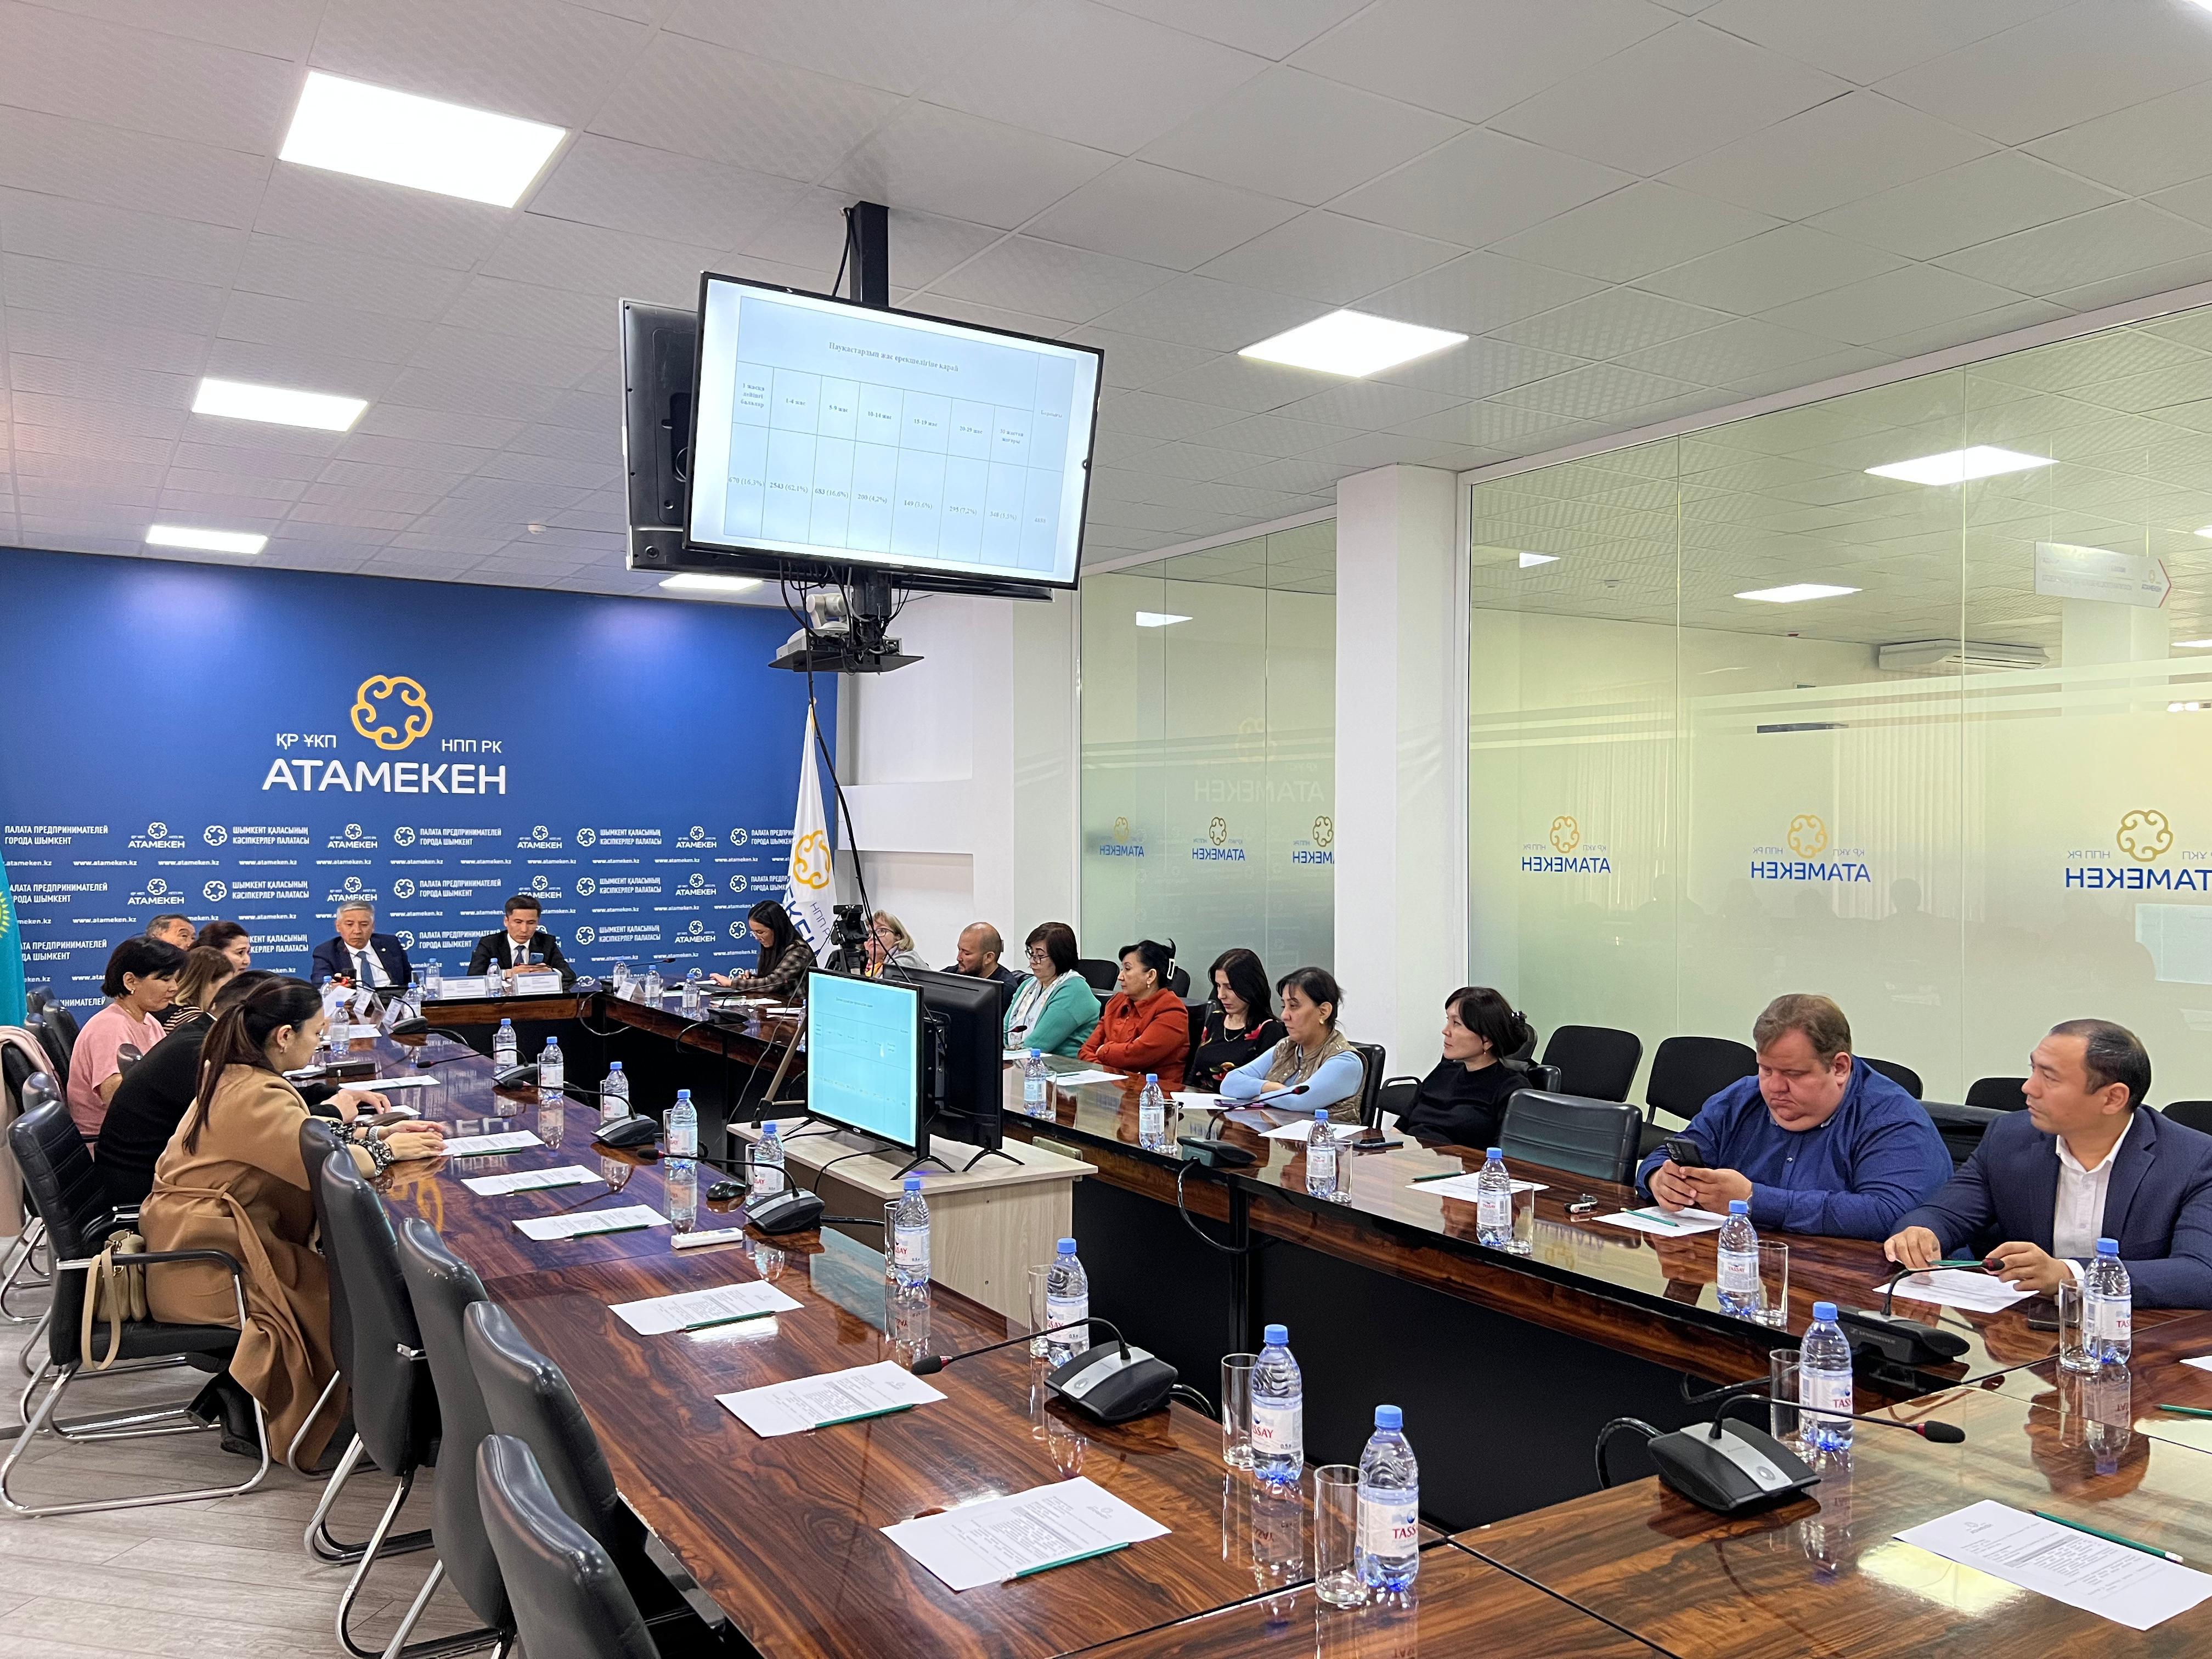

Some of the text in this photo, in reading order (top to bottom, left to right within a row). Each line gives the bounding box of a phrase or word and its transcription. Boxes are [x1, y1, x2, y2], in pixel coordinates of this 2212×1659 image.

[276, 733, 336, 750] ҚР ҰКП
[442, 739, 502, 753] НПП РК
[262, 758, 505, 794] АТАМЕКЕН
[5, 825, 108, 834] ПАЛАТА ПРЕДПРИНИМАТЕЛЕЙ
[443, 828, 501, 836] ПРЕДПРИНИМАТЕЛЕЙ
[5, 837, 71, 845] ГОРОДА ШЫМКЕНТ
[33, 882, 108, 892] ПРЕДПРИНИМАТЕЛЕЙ
[442, 879, 501, 888] ПРЕДПРИНИМАТЕЛЕЙ
[13, 894, 71, 904] РОДА ШЫМКЕНТ
[127, 896, 185, 905] АТАМЕКЕН
[32, 939, 107, 950] ПРЕДПРИНИМАТЕЛЕЙ
[276, 944, 308, 952] ПАЛАТАСЫ
[419, 941, 441, 949] ГОРОДА
[33, 952, 70, 961] ШЫМКЕНТ
[59, 997, 105, 1007] ИНИМАТЕЛЕЙ
